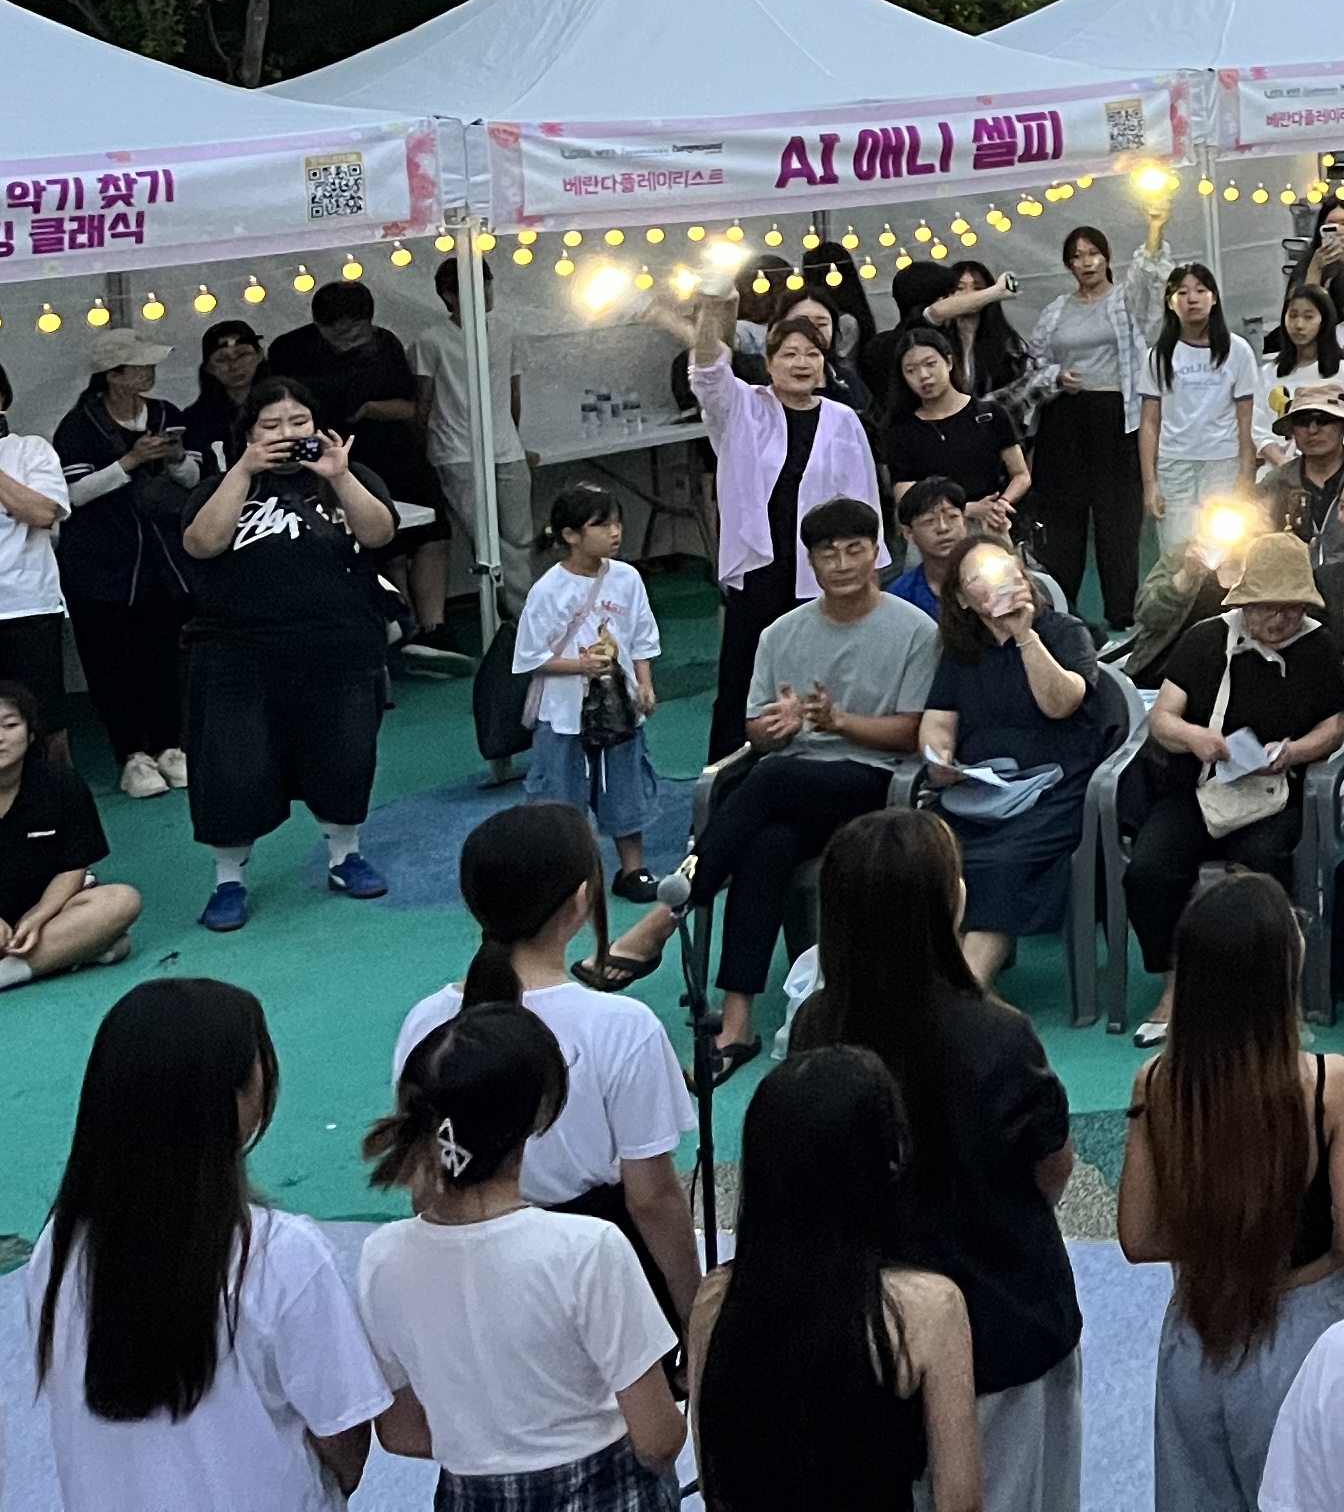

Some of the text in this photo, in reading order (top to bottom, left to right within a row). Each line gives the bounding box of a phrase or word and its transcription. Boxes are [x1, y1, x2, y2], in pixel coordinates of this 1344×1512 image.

[775, 110, 1063, 188] AI 애니 셀피
[6, 169, 175, 214] 악기 찾기
[563, 168, 725, 196] 베란다플레이리스트
[29, 210, 146, 255] 클래식
